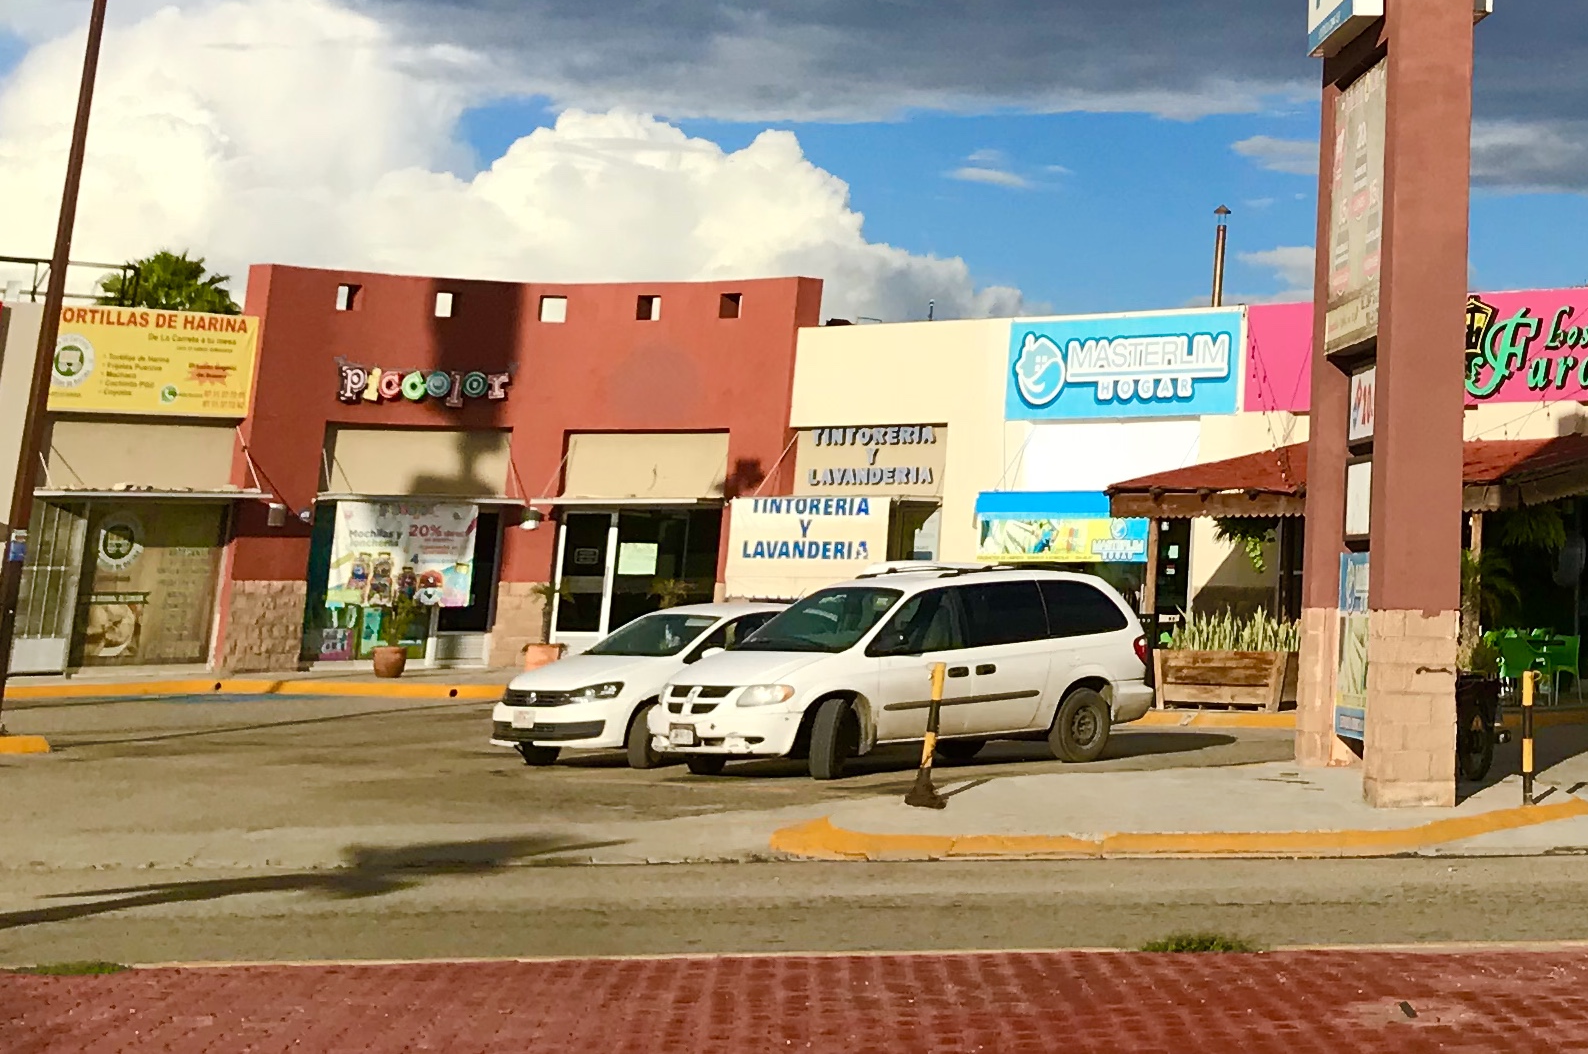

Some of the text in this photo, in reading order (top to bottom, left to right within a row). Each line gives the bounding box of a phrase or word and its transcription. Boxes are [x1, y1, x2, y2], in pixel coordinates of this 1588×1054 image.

[61, 307, 248, 334] ORTILLAS DE HARINA
[1068, 335, 1229, 370] MASTERLIM
[339, 366, 510, 408] piccolor
[1099, 377, 1191, 398] HOGAR
[812, 426, 937, 446] TINTORERIA
[866, 448, 879, 465] Y
[808, 467, 934, 486] LAVANDERIA
[752, 497, 870, 516] TINTORERIA
[800, 519, 812, 538] Y
[742, 540, 869, 560] LAVANDERIA
